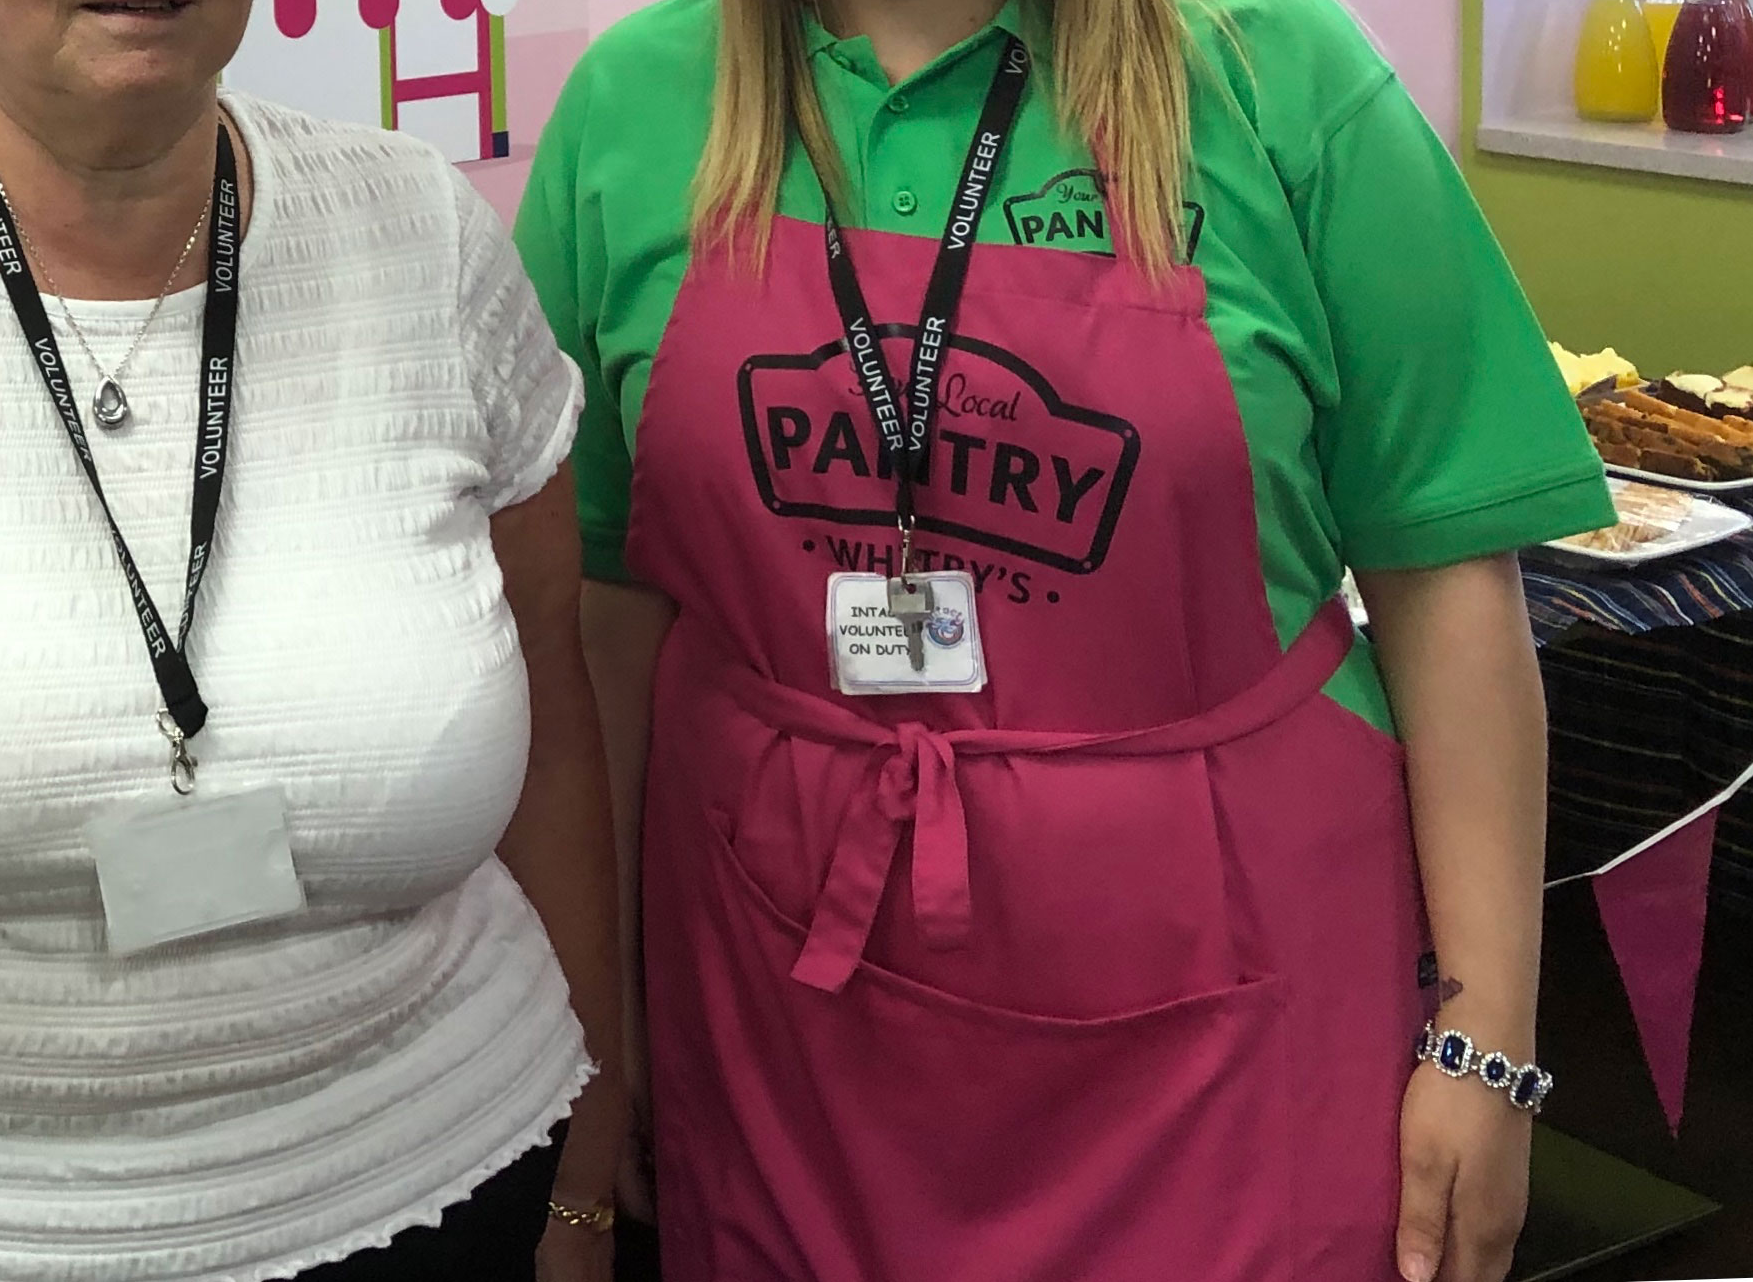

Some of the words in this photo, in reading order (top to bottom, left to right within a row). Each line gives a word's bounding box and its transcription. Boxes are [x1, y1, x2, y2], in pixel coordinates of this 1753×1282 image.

[215, 177, 234, 293] VOLUNTEER
[947, 131, 1001, 251] VOLUNTEER
[1020, 210, 1104, 244] PAN
[1056, 183, 1097, 203] Your
[33, 337, 92, 464] VOLUNTEER
[199, 355, 229, 479] VOLUNTEER
[849, 317, 904, 451] VOLUNTEER
[909, 317, 946, 451] VOLUNTEER
[936, 373, 1021, 422] Local
[849, 644, 870, 655] ON
